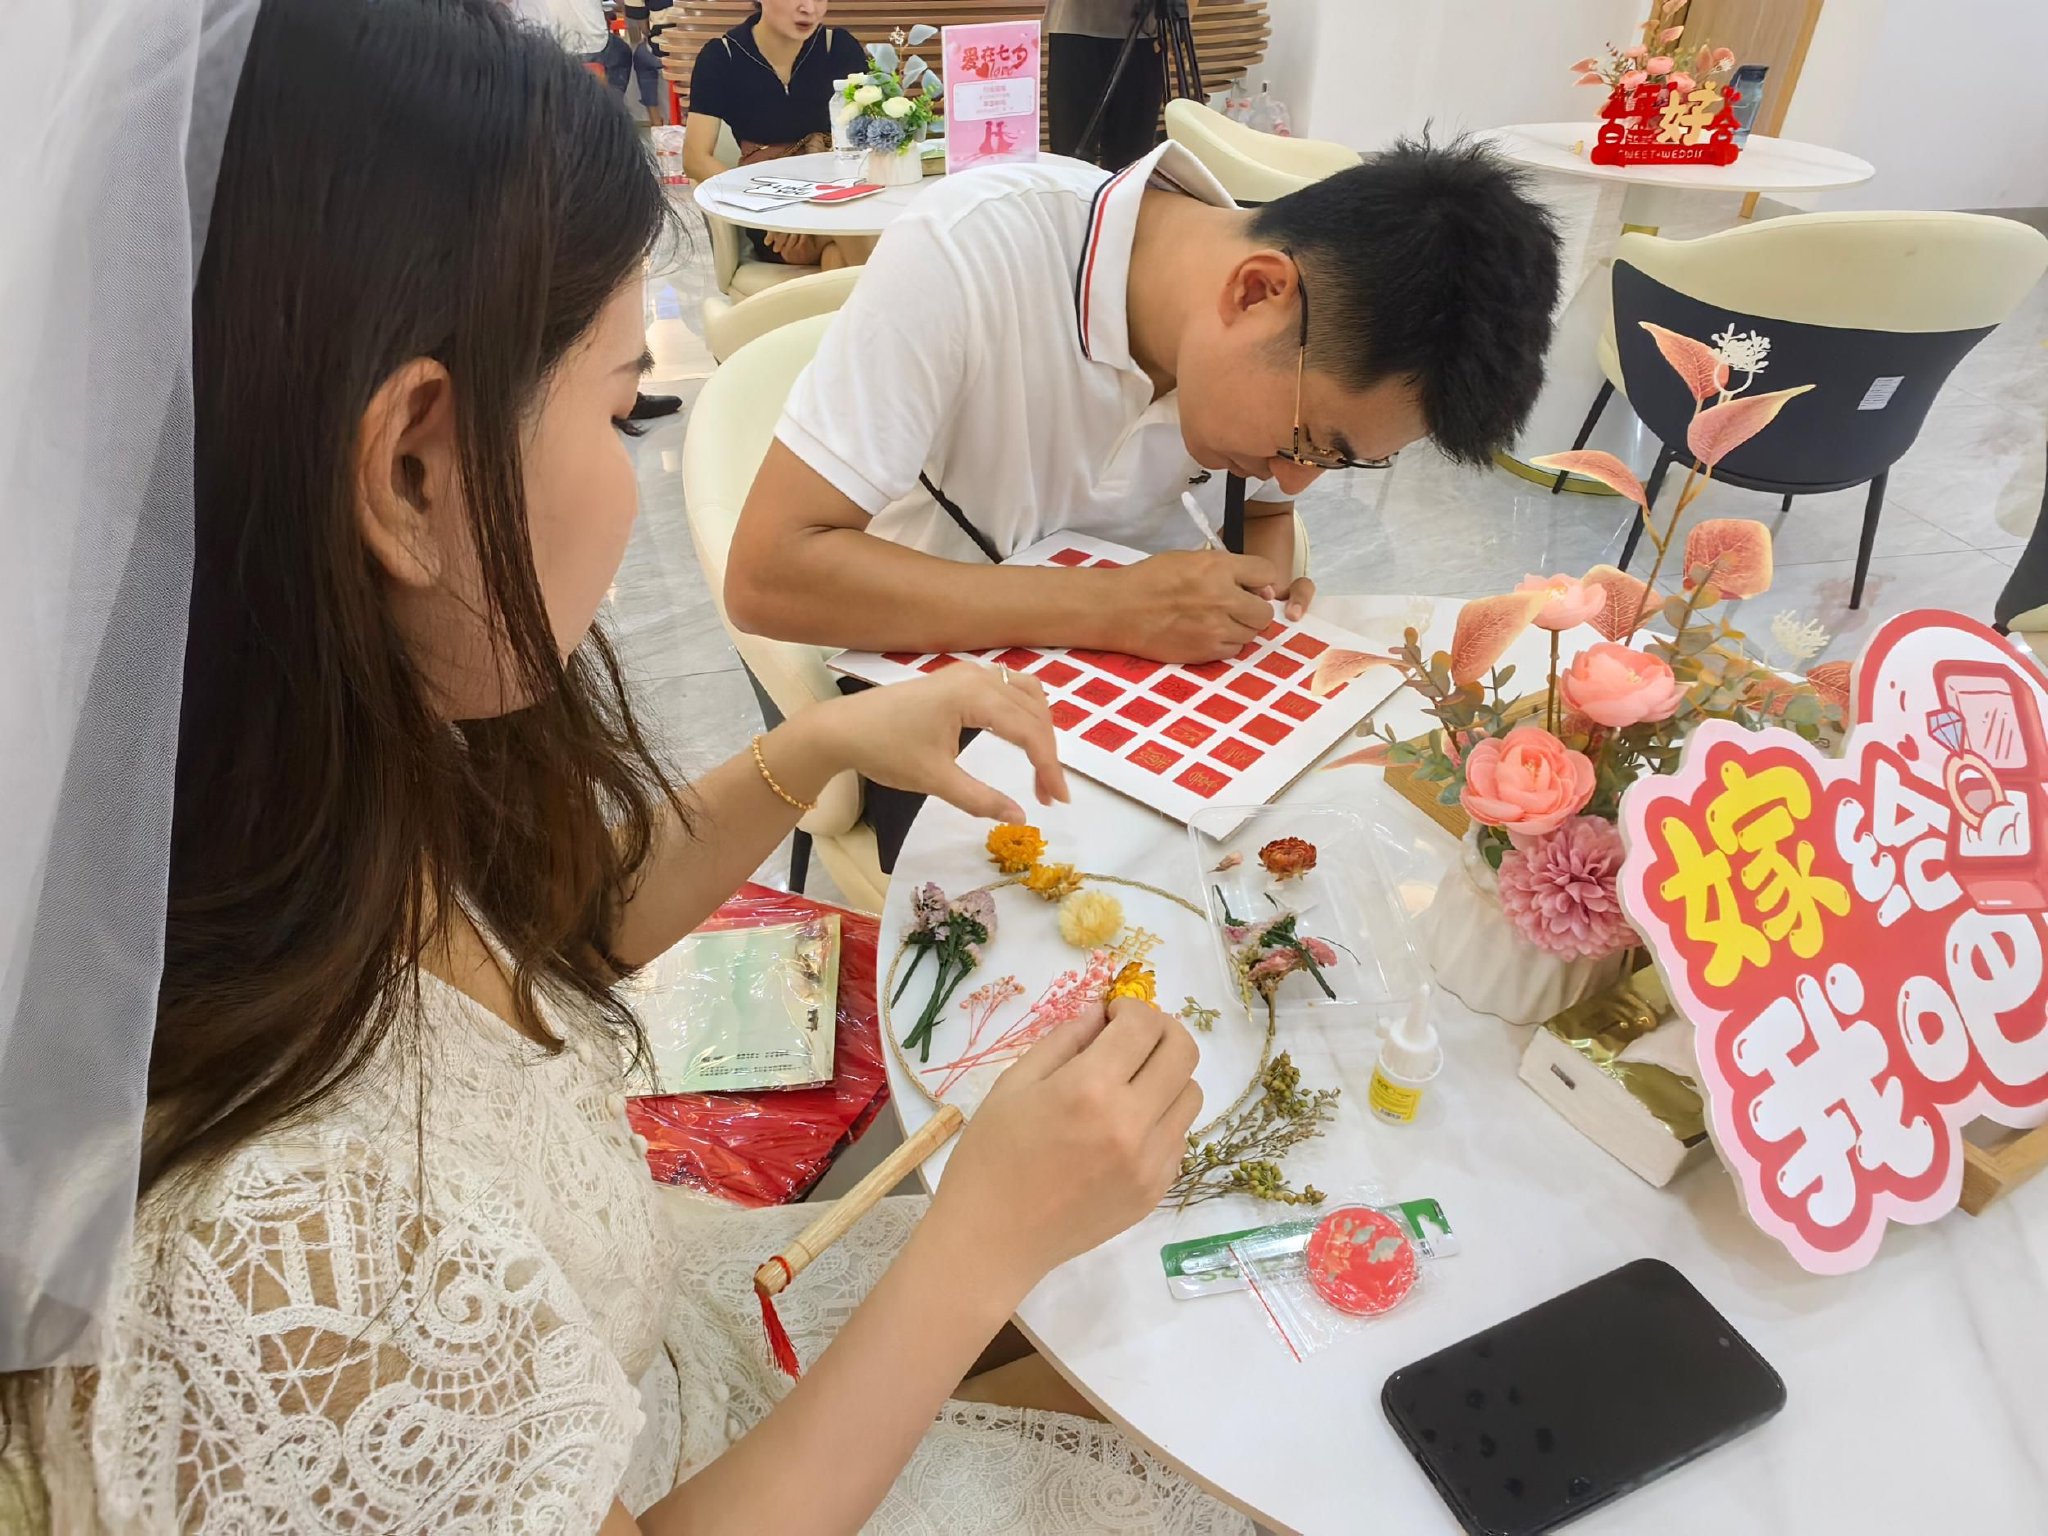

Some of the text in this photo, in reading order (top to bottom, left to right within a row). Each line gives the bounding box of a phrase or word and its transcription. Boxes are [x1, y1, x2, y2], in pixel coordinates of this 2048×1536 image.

[961, 43, 1028, 72] 爱在七夕
[1660, 759, 1963, 987] 嫁给
[1732, 908, 2048, 1227] 我吧
